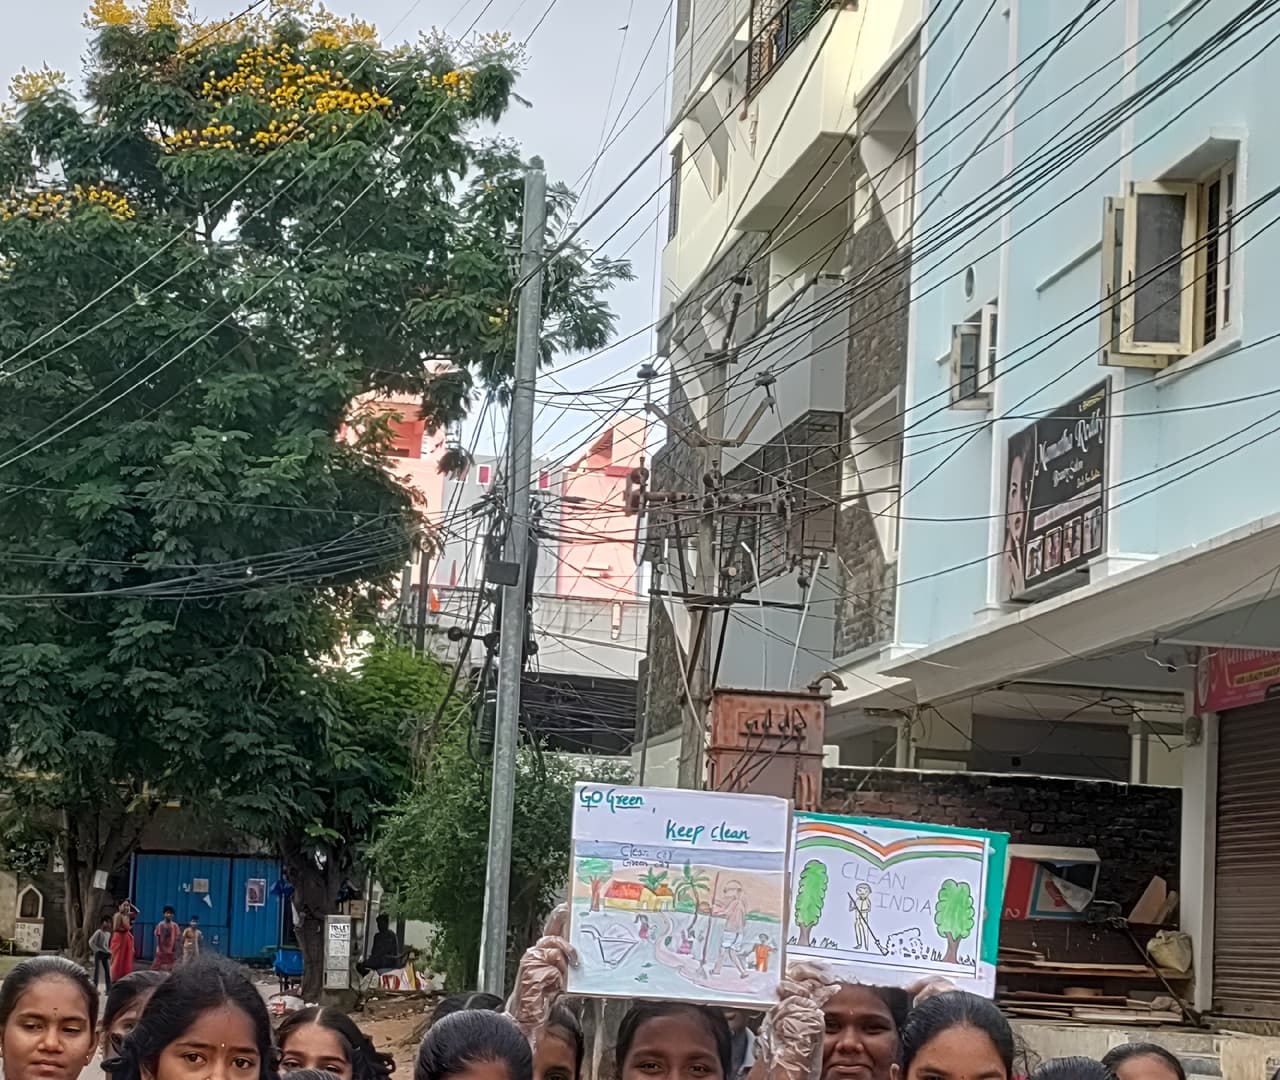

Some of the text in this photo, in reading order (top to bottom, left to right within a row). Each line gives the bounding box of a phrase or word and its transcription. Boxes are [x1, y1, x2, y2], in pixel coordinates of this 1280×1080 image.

[606, 788, 645, 814] Green
[665, 819, 705, 845] Keep
[841, 861, 907, 890] CLEAN
[875, 891, 933, 917] INDIA
